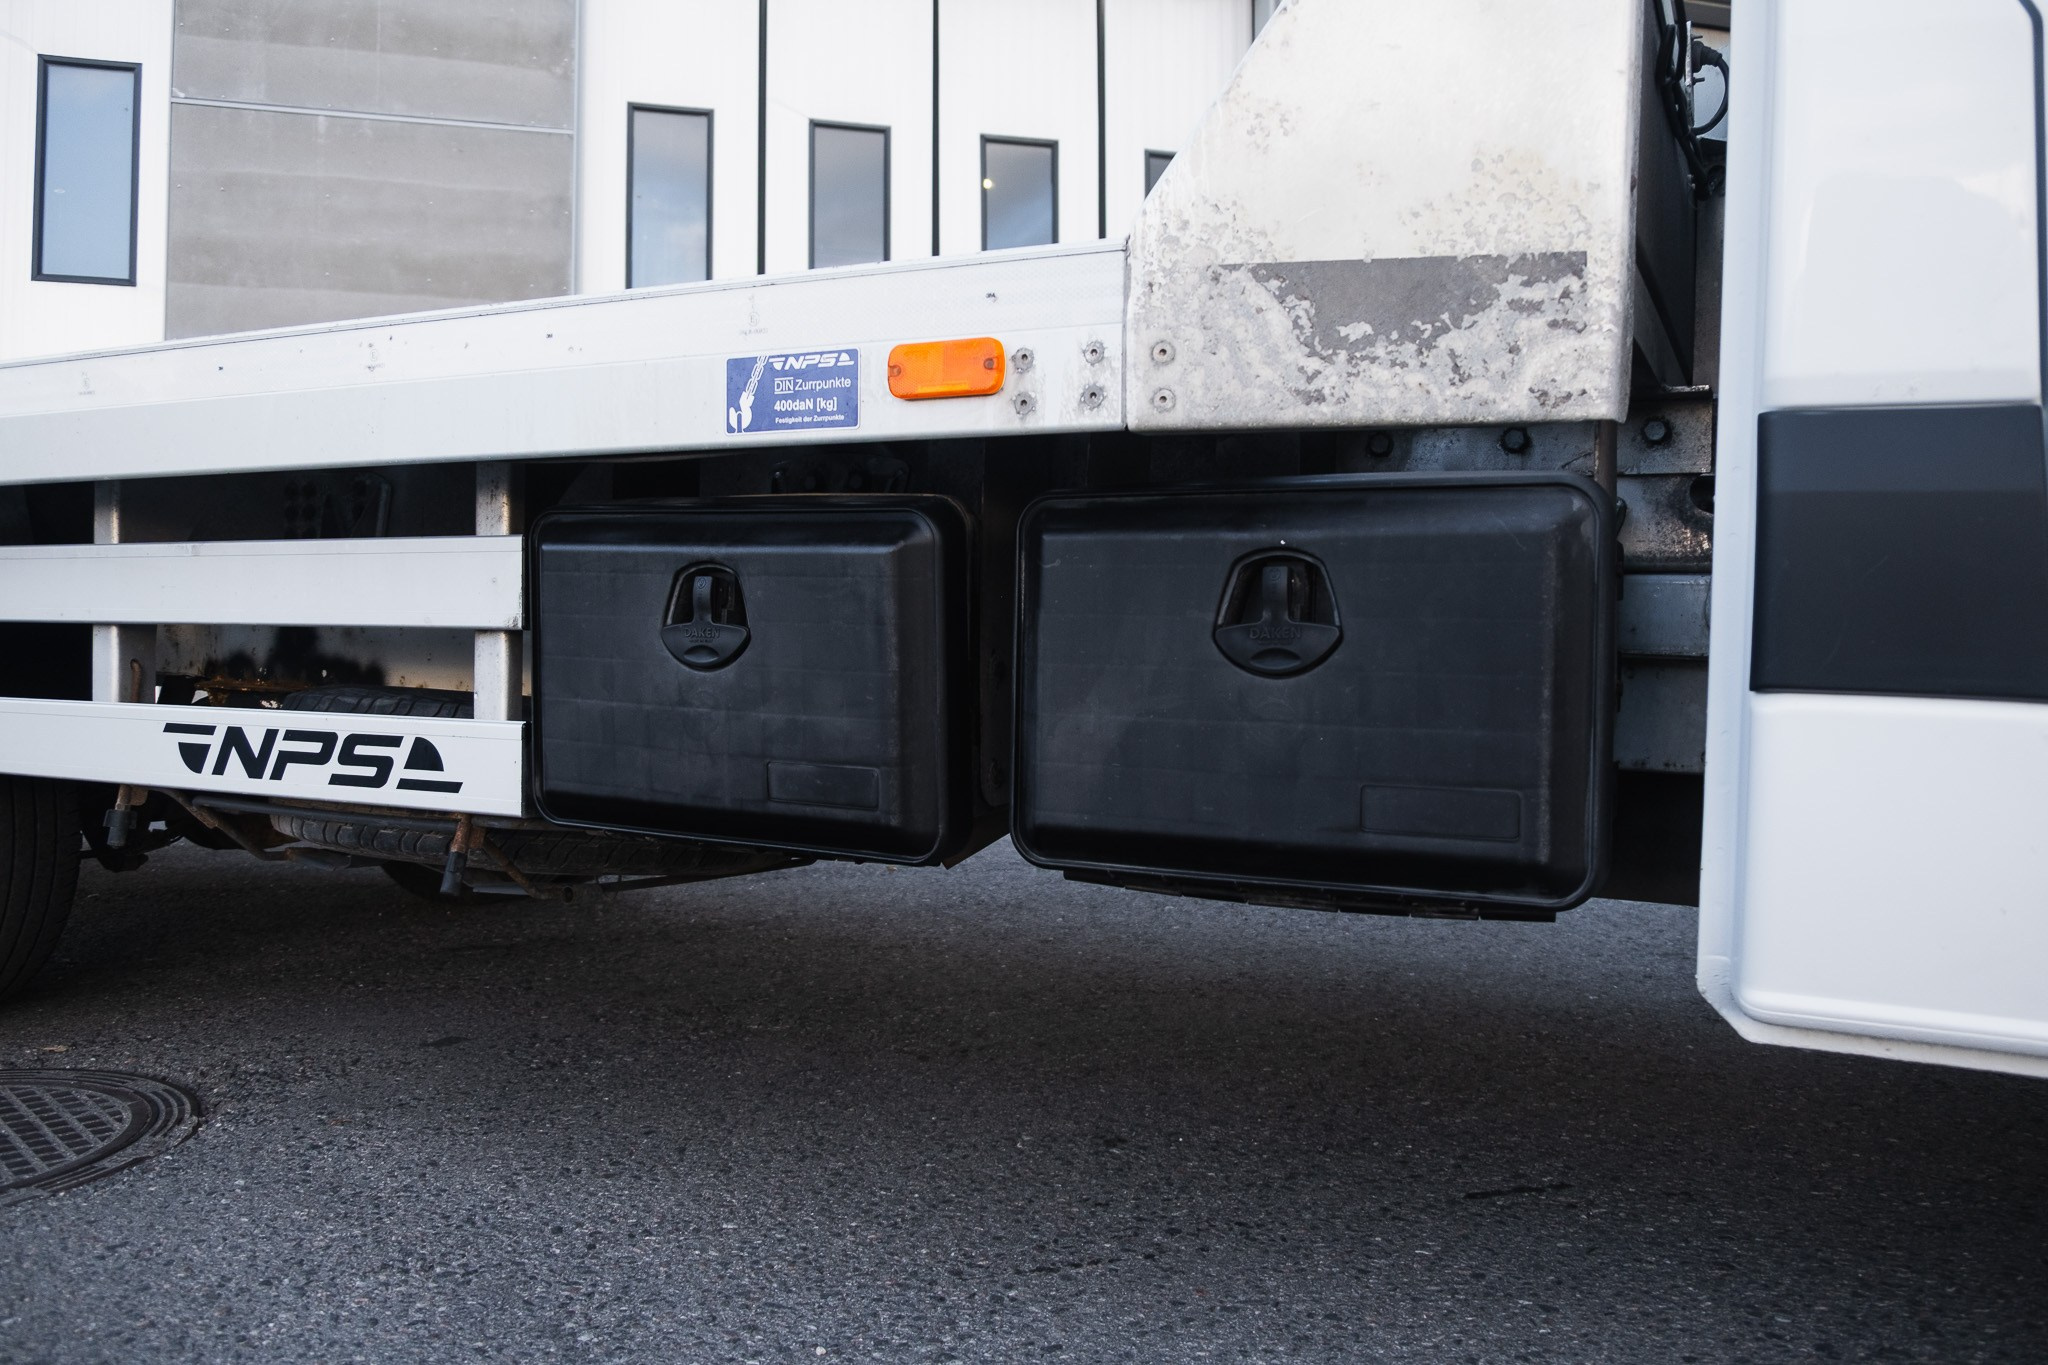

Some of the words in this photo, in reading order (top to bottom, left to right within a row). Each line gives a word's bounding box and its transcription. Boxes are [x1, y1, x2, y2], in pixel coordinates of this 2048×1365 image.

[784, 353, 839, 370] NPS
[774, 379, 794, 392] DIN
[795, 376, 852, 392] Zurrpunkte
[774, 398, 814, 411] 400daN
[817, 397, 838, 412] [kg]
[775, 416, 803, 425] Festigkeit
[813, 414, 845, 423] Zurrpunkte
[684, 627, 720, 638] DAKEN
[1249, 627, 1302, 639] DAKEN
[212, 725, 404, 789] NPS
